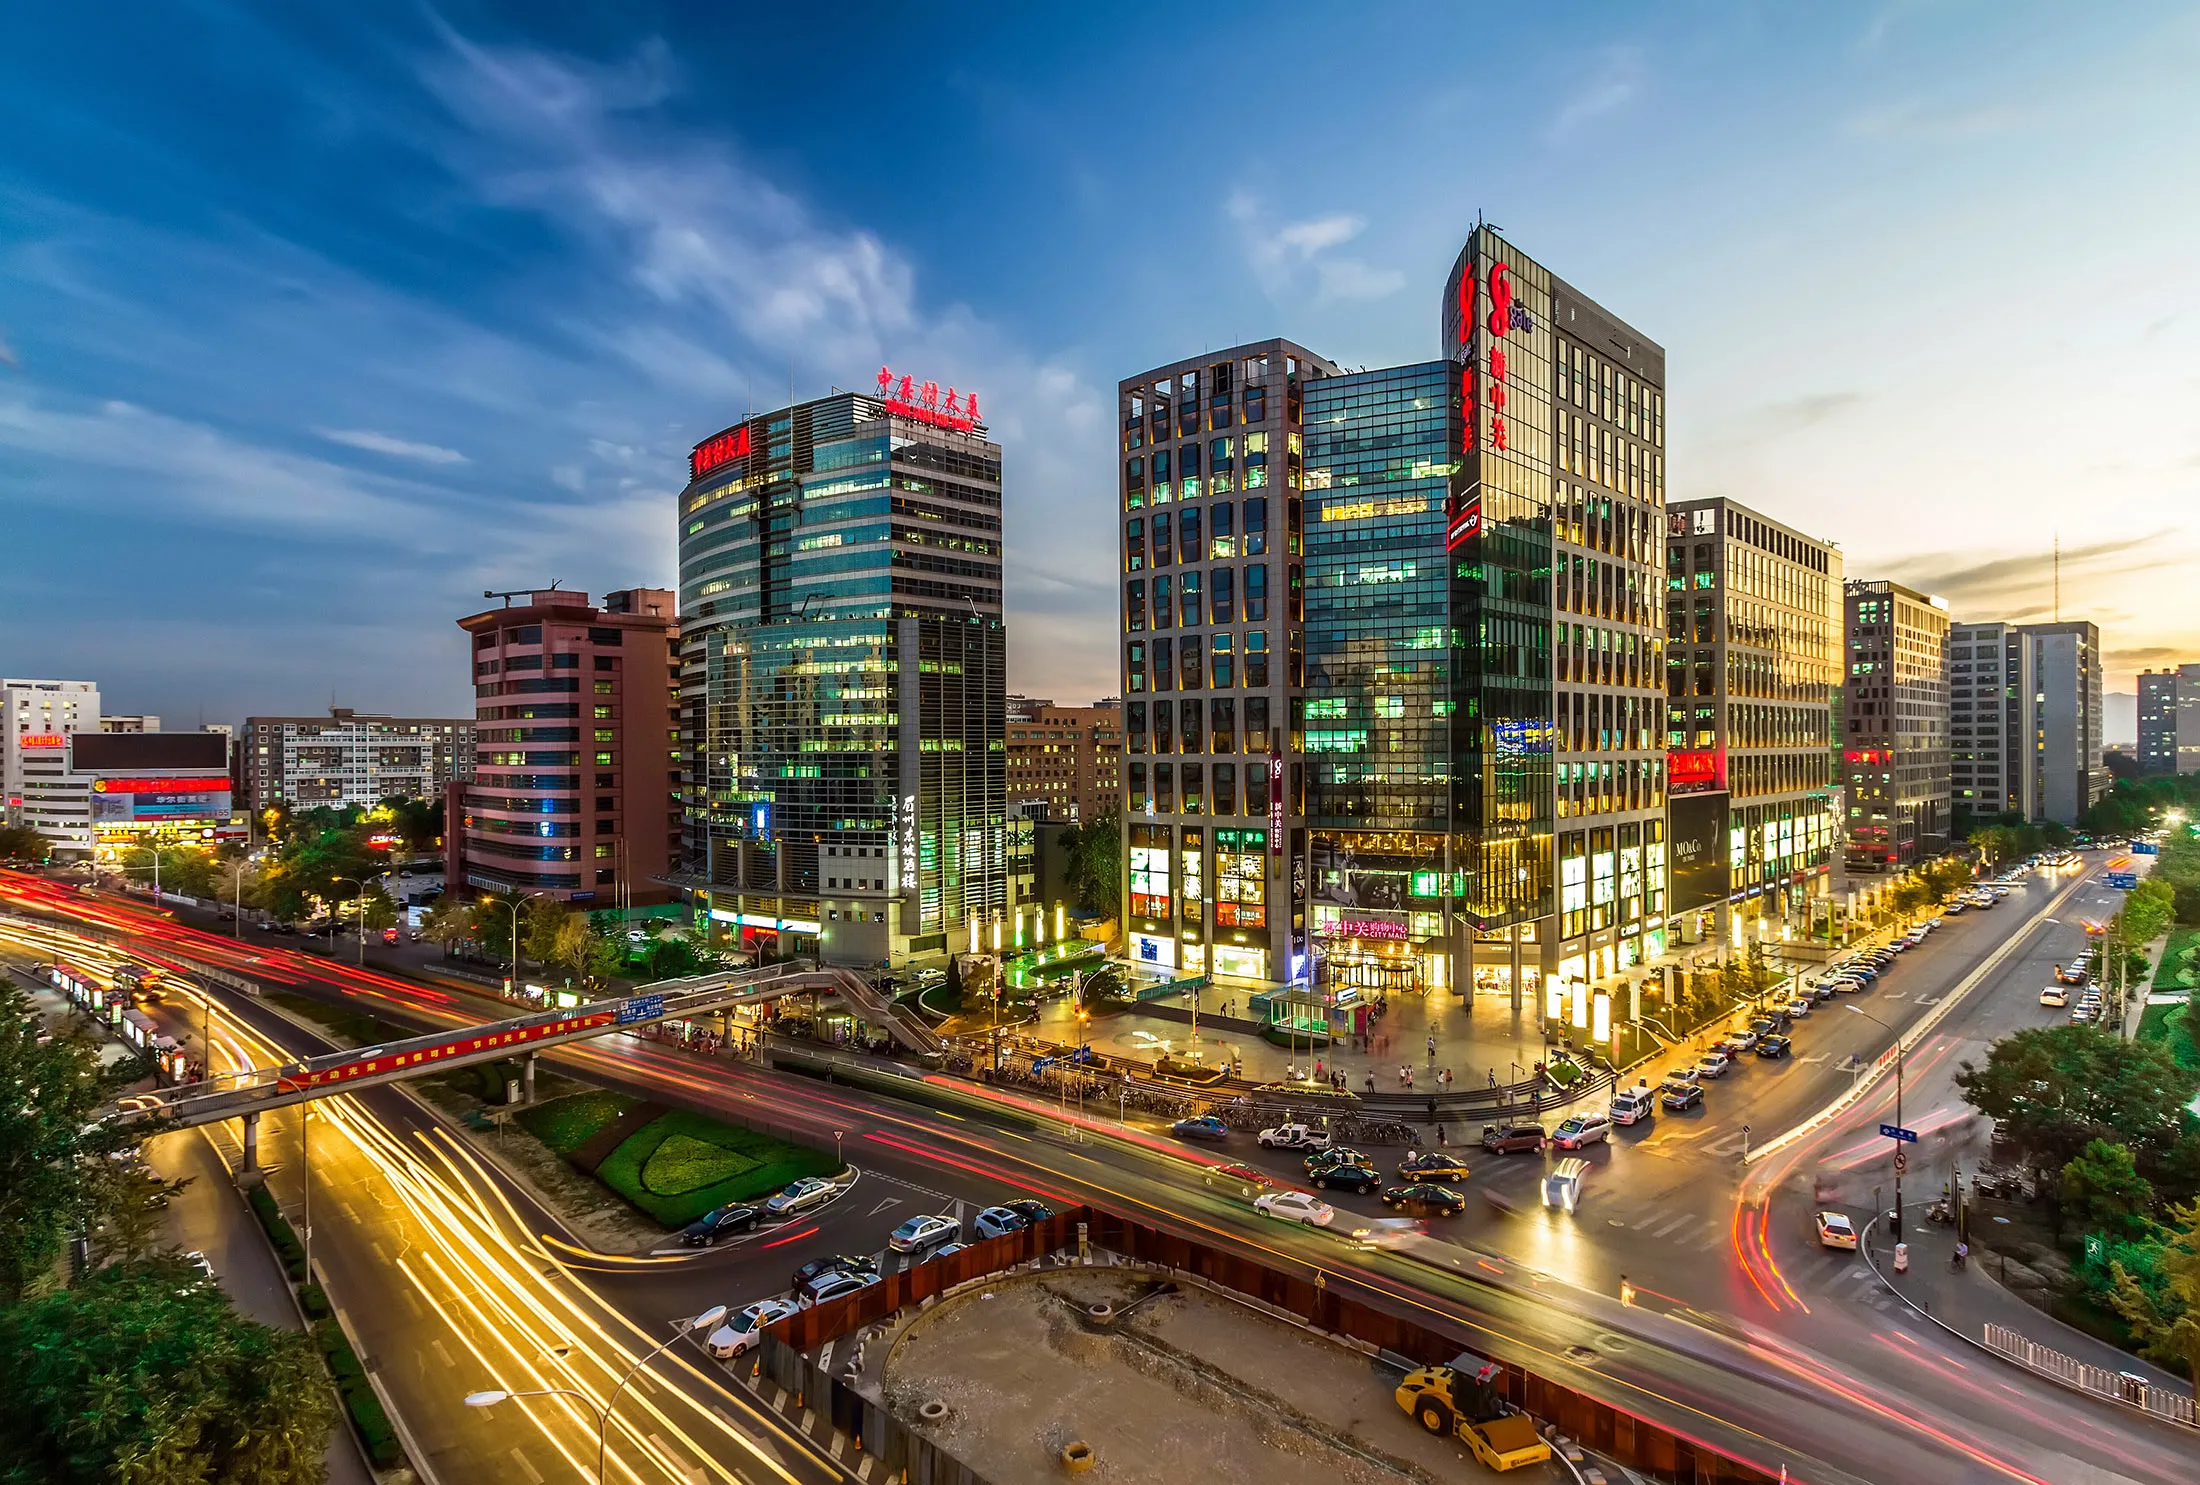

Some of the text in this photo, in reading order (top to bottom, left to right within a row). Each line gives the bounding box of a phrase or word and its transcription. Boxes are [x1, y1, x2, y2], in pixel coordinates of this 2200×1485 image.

[901, 795, 917, 888] 眉州东坡酒楼
